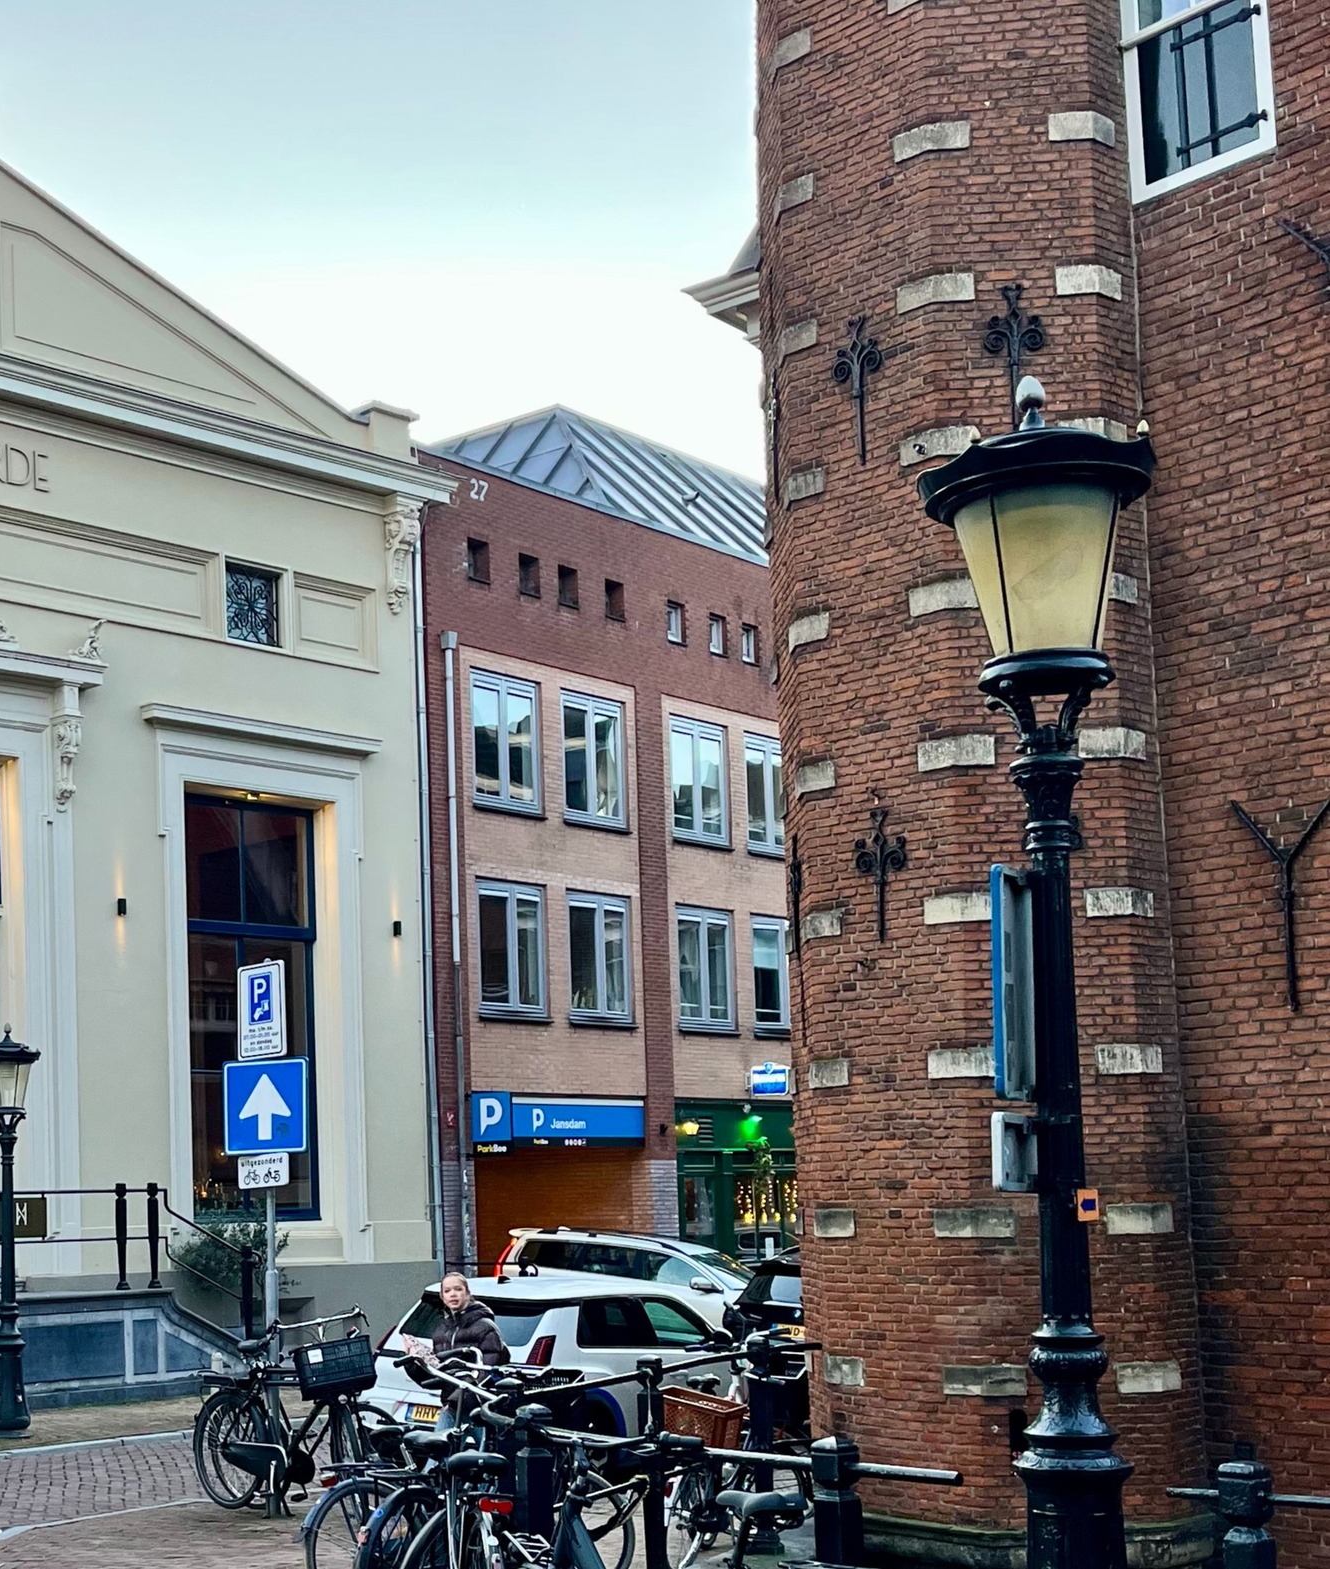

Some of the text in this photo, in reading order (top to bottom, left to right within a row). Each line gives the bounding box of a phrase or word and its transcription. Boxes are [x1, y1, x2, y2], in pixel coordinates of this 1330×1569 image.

[470, 478, 489, 502] 27
[253, 978, 267, 1004] P
[479, 1097, 503, 1136] P
[532, 1108, 587, 1133] P Jansdam
[477, 1144, 507, 1153] ParkBee
[240, 1156, 283, 1168] uitgezonderd
